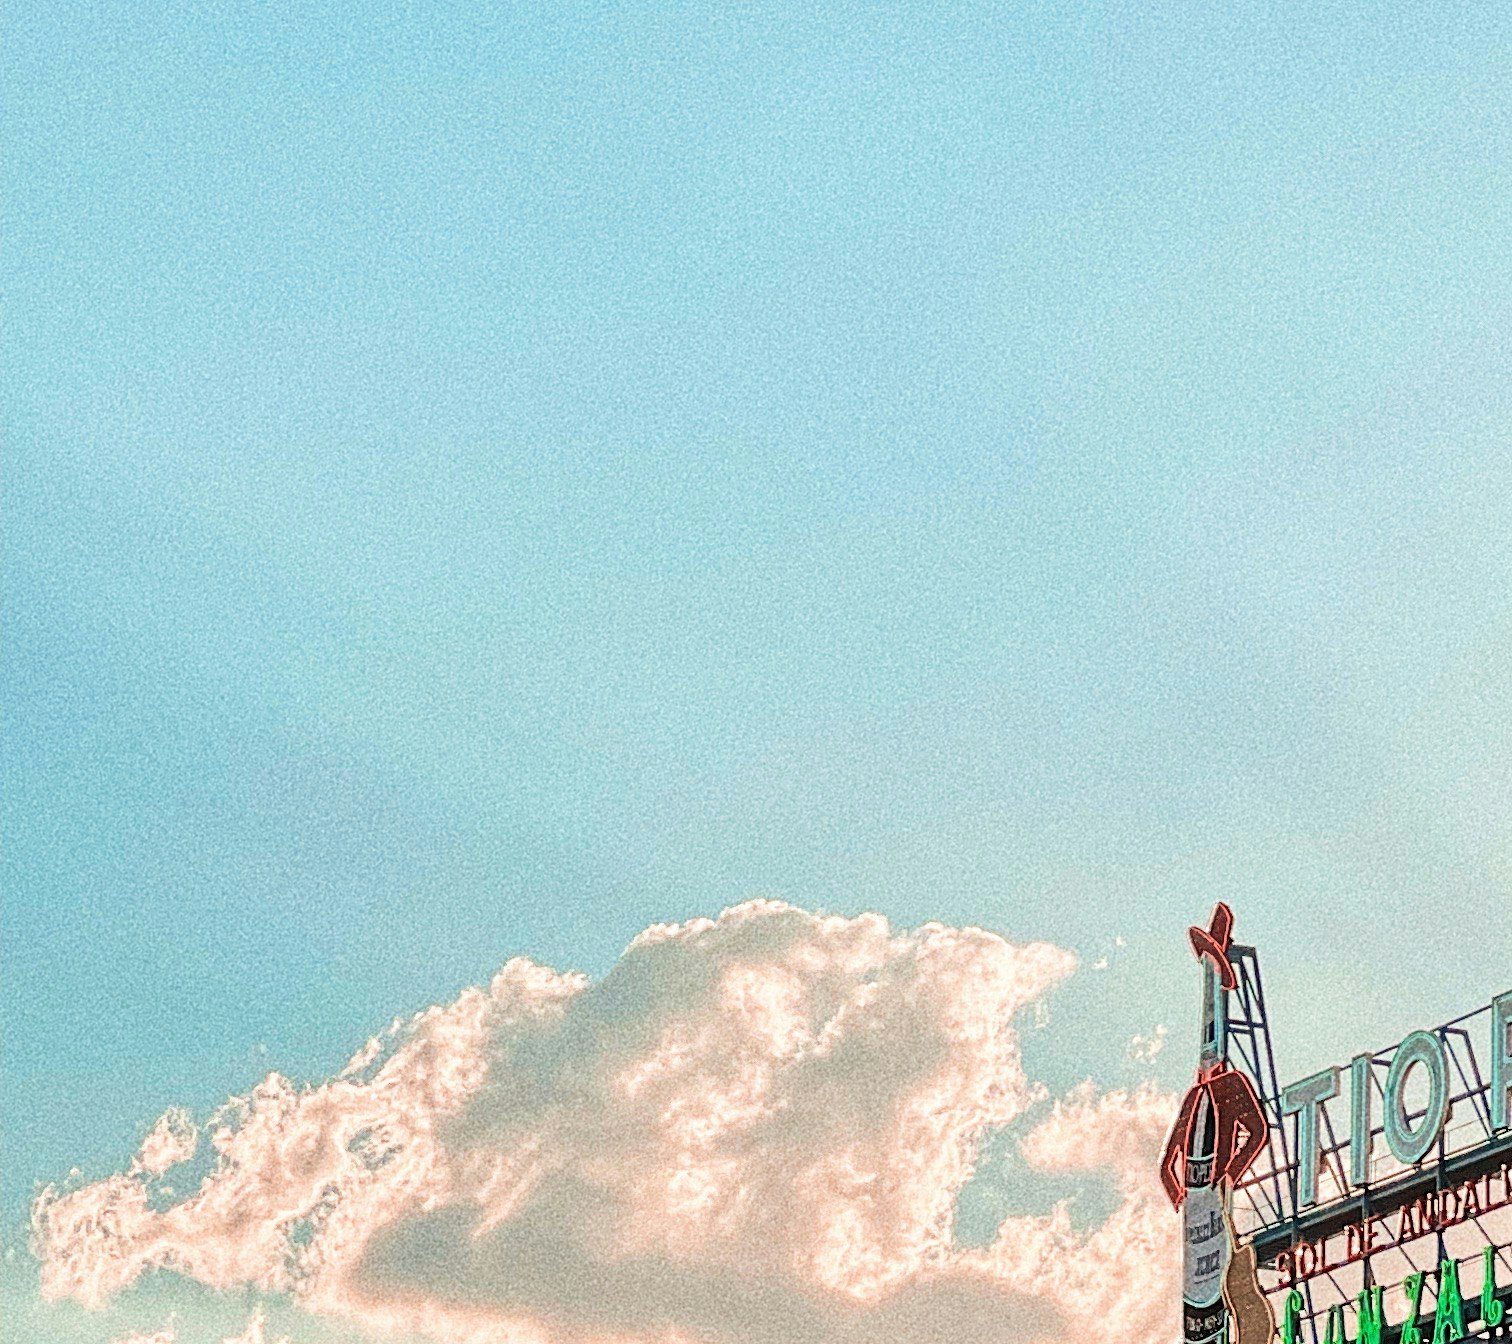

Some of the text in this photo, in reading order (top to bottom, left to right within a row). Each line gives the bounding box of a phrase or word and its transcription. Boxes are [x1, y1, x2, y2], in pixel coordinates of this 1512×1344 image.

[1282, 1030, 1451, 1207] TIO
[1276, 1236, 1330, 1286] SOL
[1343, 1214, 1387, 1260] DE
